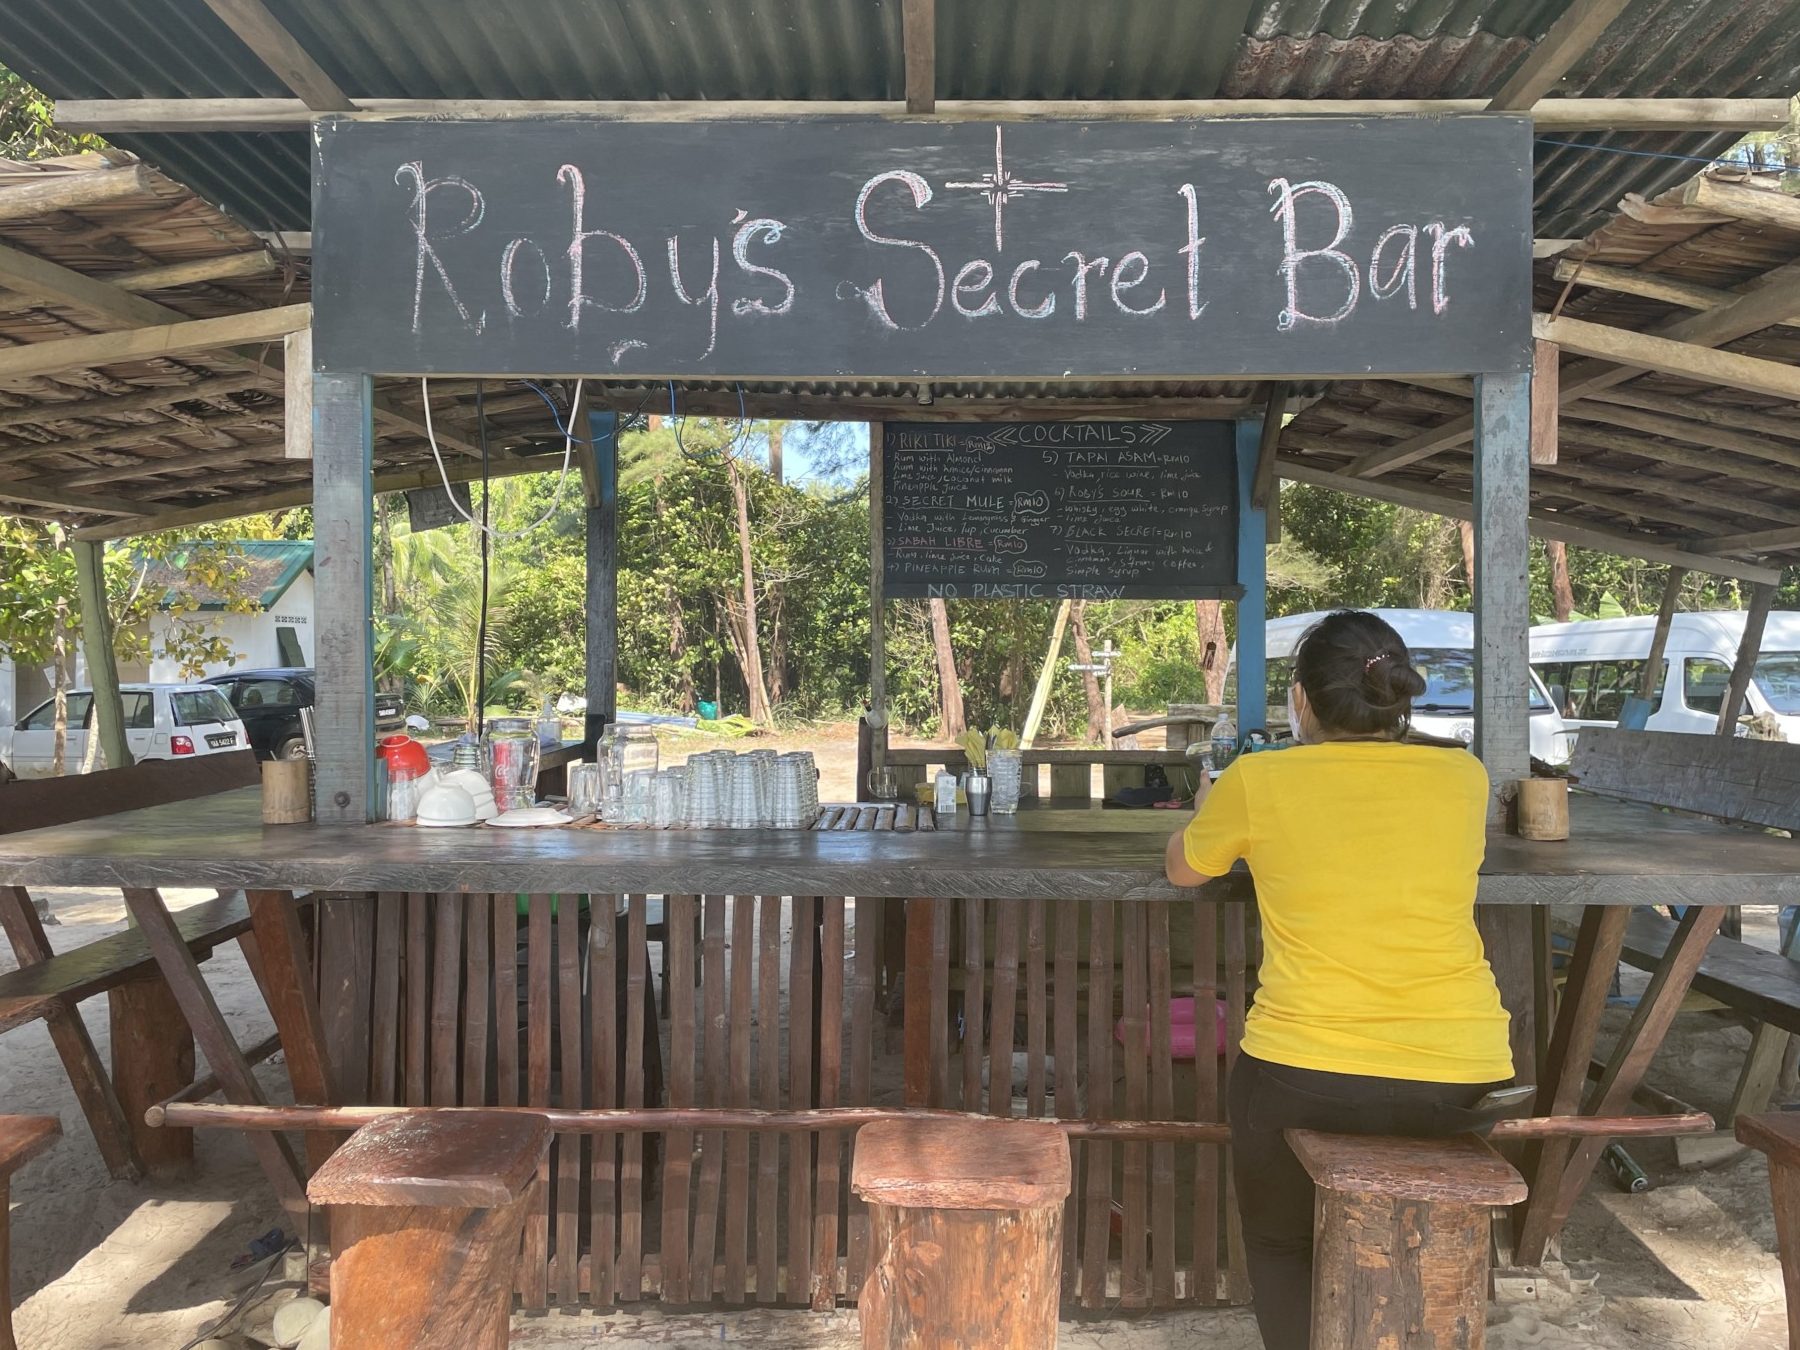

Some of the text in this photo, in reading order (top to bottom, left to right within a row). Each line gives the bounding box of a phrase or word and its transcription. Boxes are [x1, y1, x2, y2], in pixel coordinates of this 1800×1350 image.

[394, 160, 1476, 363] Roby's Secret Bar
[1018, 424, 1137, 443] COCKTAILS
[900, 433, 928, 448] RIKI
[933, 433, 957, 447] TIKI
[946, 452, 982, 463] Almond
[1042, 450, 1059, 465] 5)
[1064, 451, 1108, 463] TAPAI
[1118, 451, 1157, 463] ASAM
[920, 463, 938, 473] with
[894, 480, 938, 492] Pineapple
[1112, 487, 1144, 498] SOUR
[885, 495, 898, 507] 2)
[902, 495, 954, 508] SECRET
[966, 495, 1005, 509] MULE
[898, 512, 927, 522] Vodka
[934, 512, 956, 521] with
[1048, 525, 1063, 535] 7)
[1064, 525, 1108, 538] BLACK
[1116, 525, 1157, 537] SECRET
[897, 536, 936, 546] SABAH
[944, 536, 984, 548] LIBRE
[904, 562, 966, 574] PINEAPPLE
[927, 583, 1126, 599] NO PLASTIC STRAW
